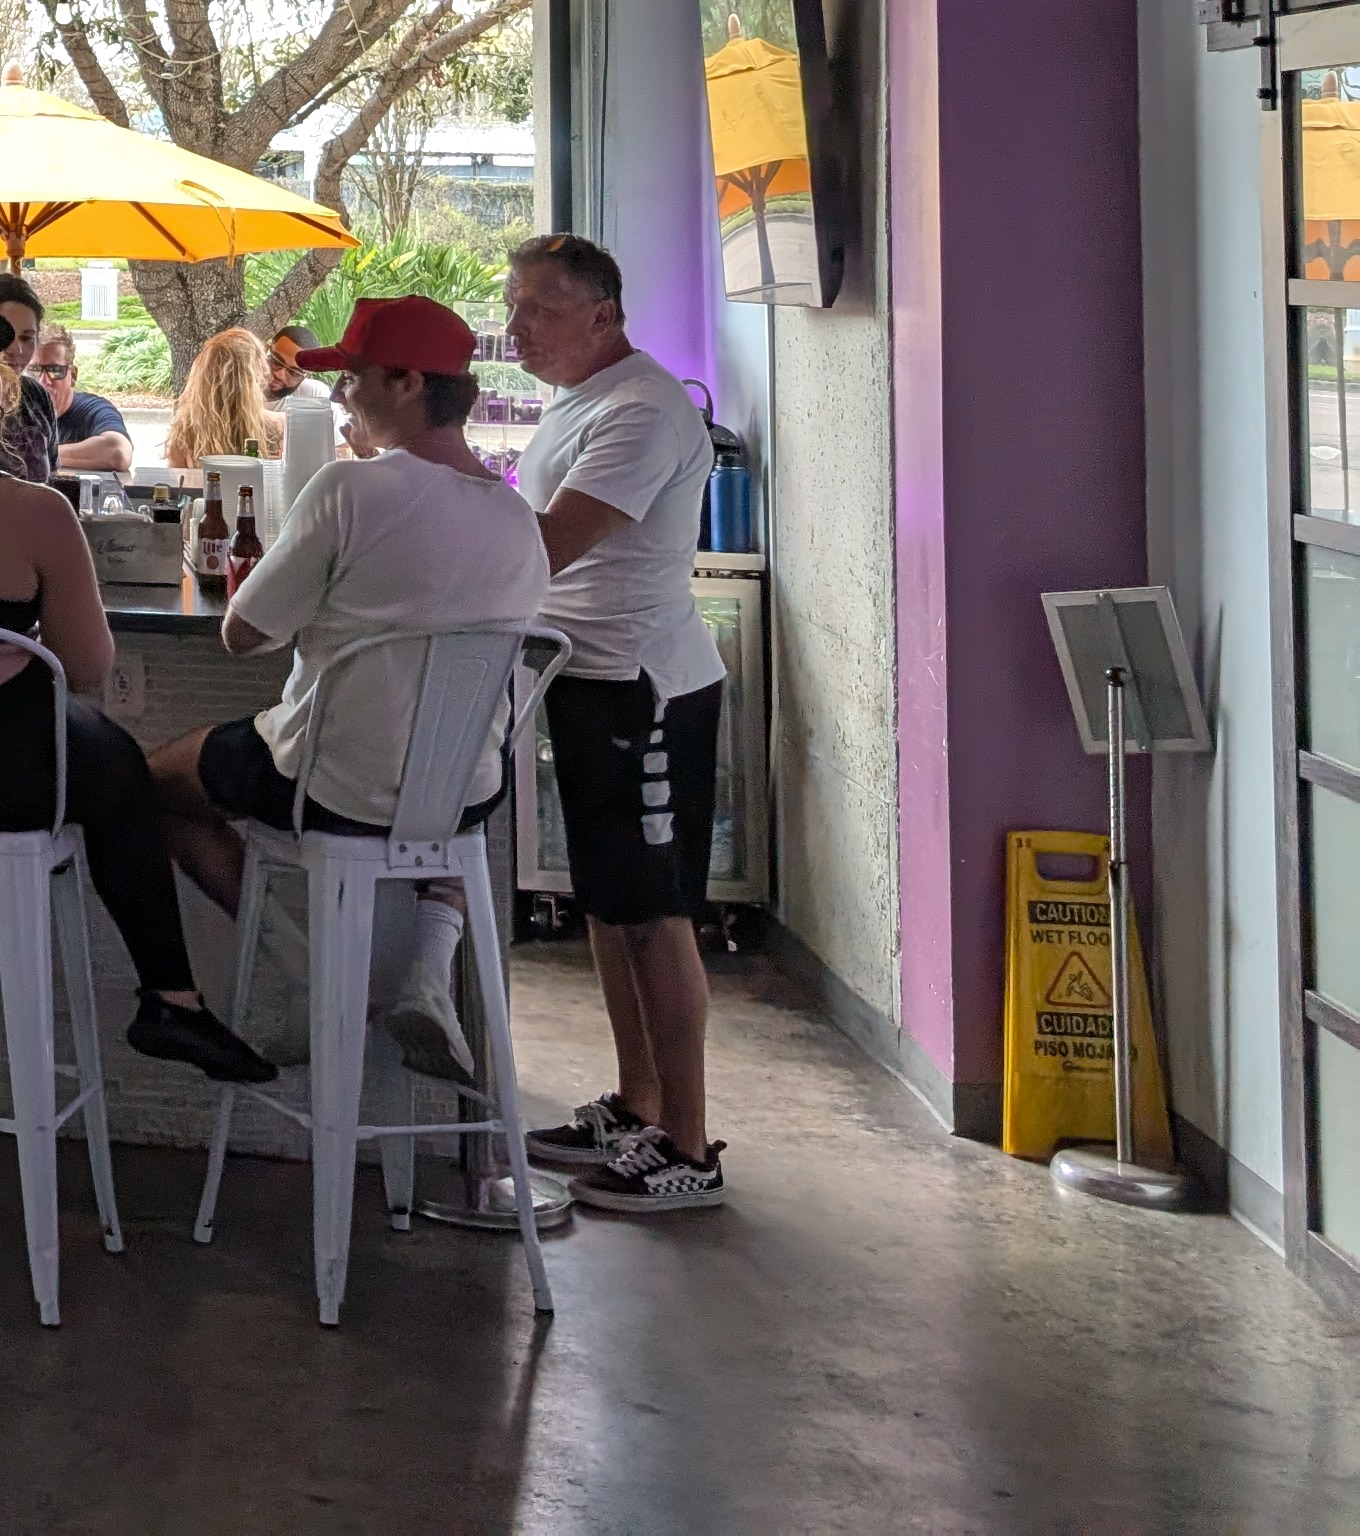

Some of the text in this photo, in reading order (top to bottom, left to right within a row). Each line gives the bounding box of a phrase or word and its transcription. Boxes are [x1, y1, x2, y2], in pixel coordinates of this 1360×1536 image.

[1030, 929, 1110, 946] WET FLOO
[1040, 1014, 1110, 1037] CUIDAD
[1034, 1039, 1069, 1058] PISO
